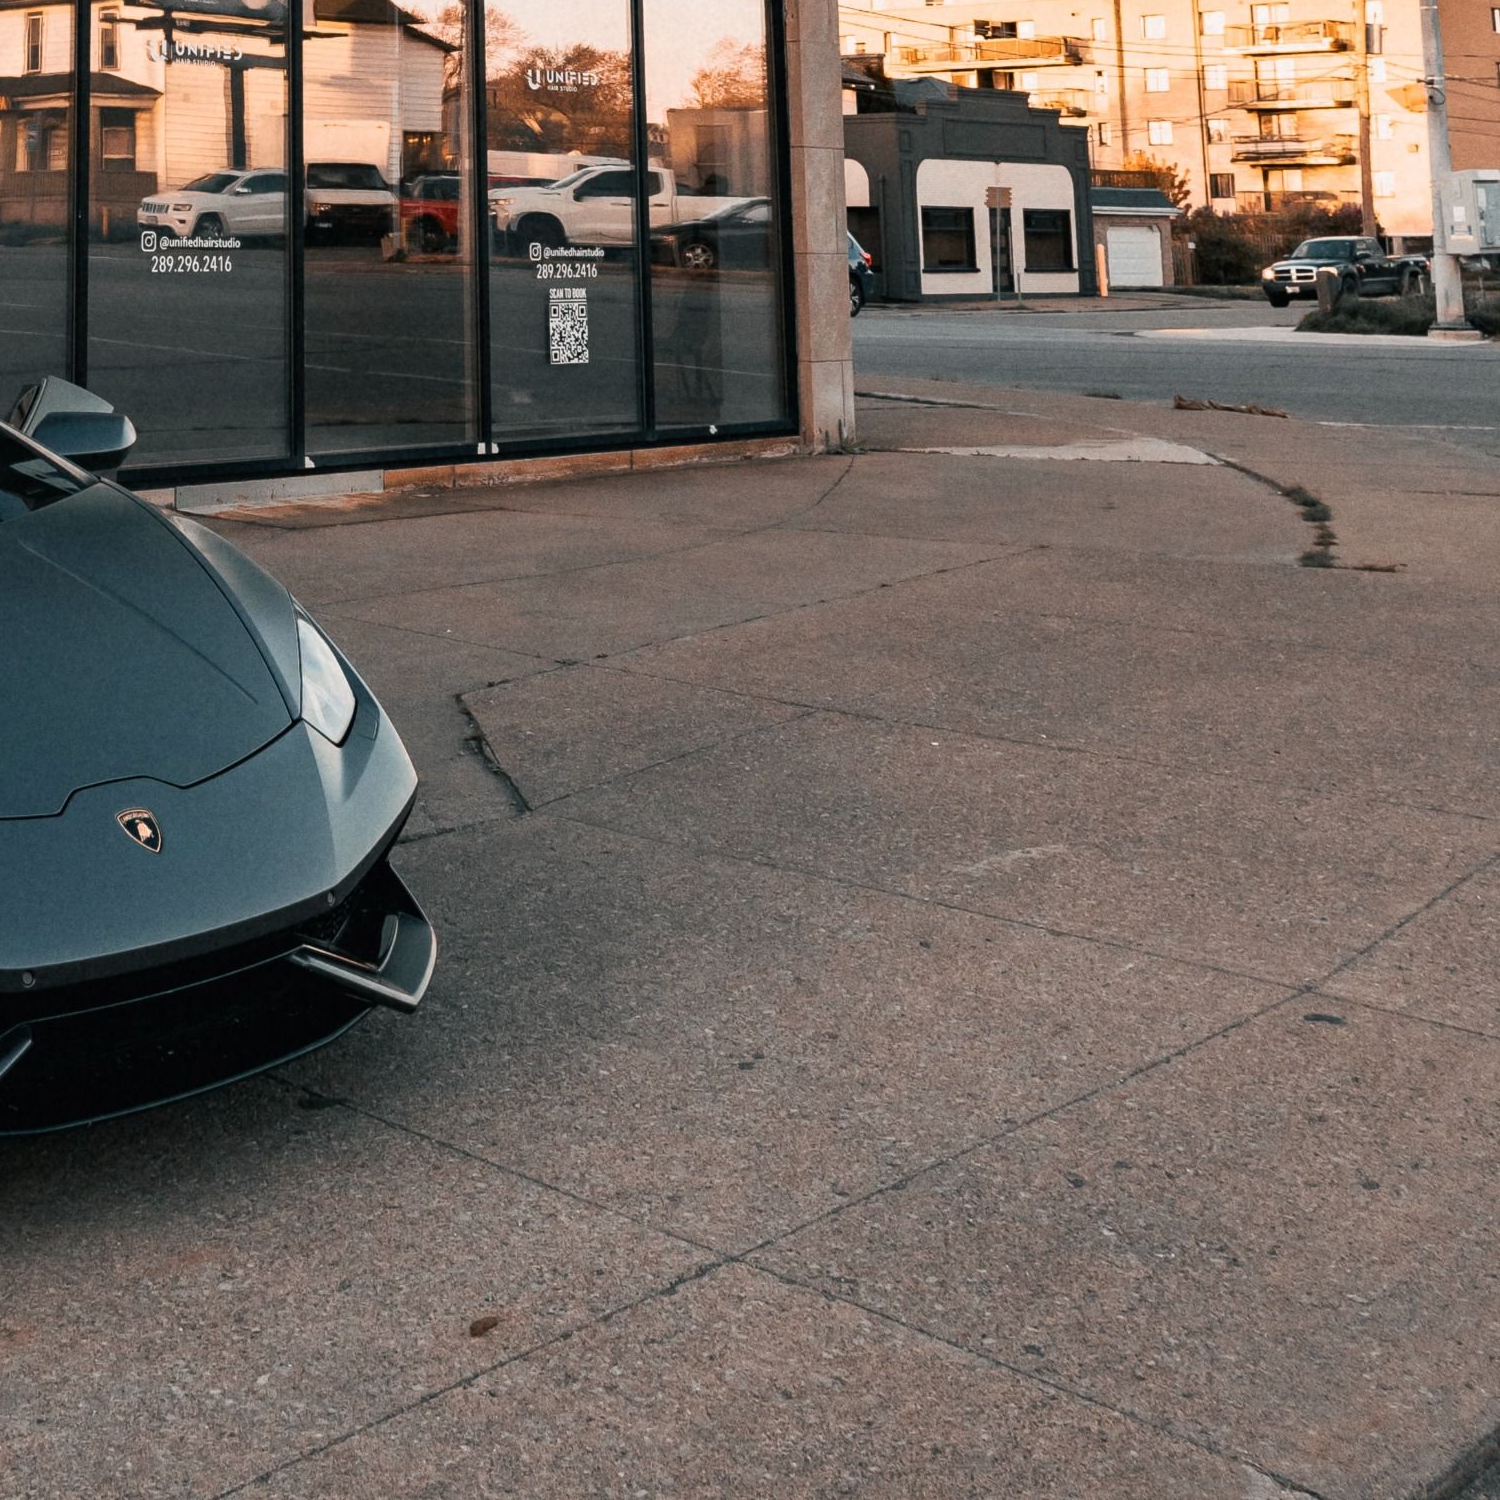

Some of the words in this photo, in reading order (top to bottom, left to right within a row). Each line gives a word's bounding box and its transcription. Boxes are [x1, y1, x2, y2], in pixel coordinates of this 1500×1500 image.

[175, 41, 242, 60] UNIFIED
[175, 58, 191, 66] HAIR
[193, 58, 216, 67] STUDIO
[546, 69, 598, 86] UNIFIED
[159, 236, 241, 250] @unifiedhairstudio
[543, 246, 605, 259] @unifiedhairstudio
[151, 255, 232, 273] 289.296.2416
[536, 263, 598, 279] 289.296.2416
[549, 287, 564, 299] SCAN
[564, 287, 572, 298] TO
[572, 287, 587, 298] BOOK
